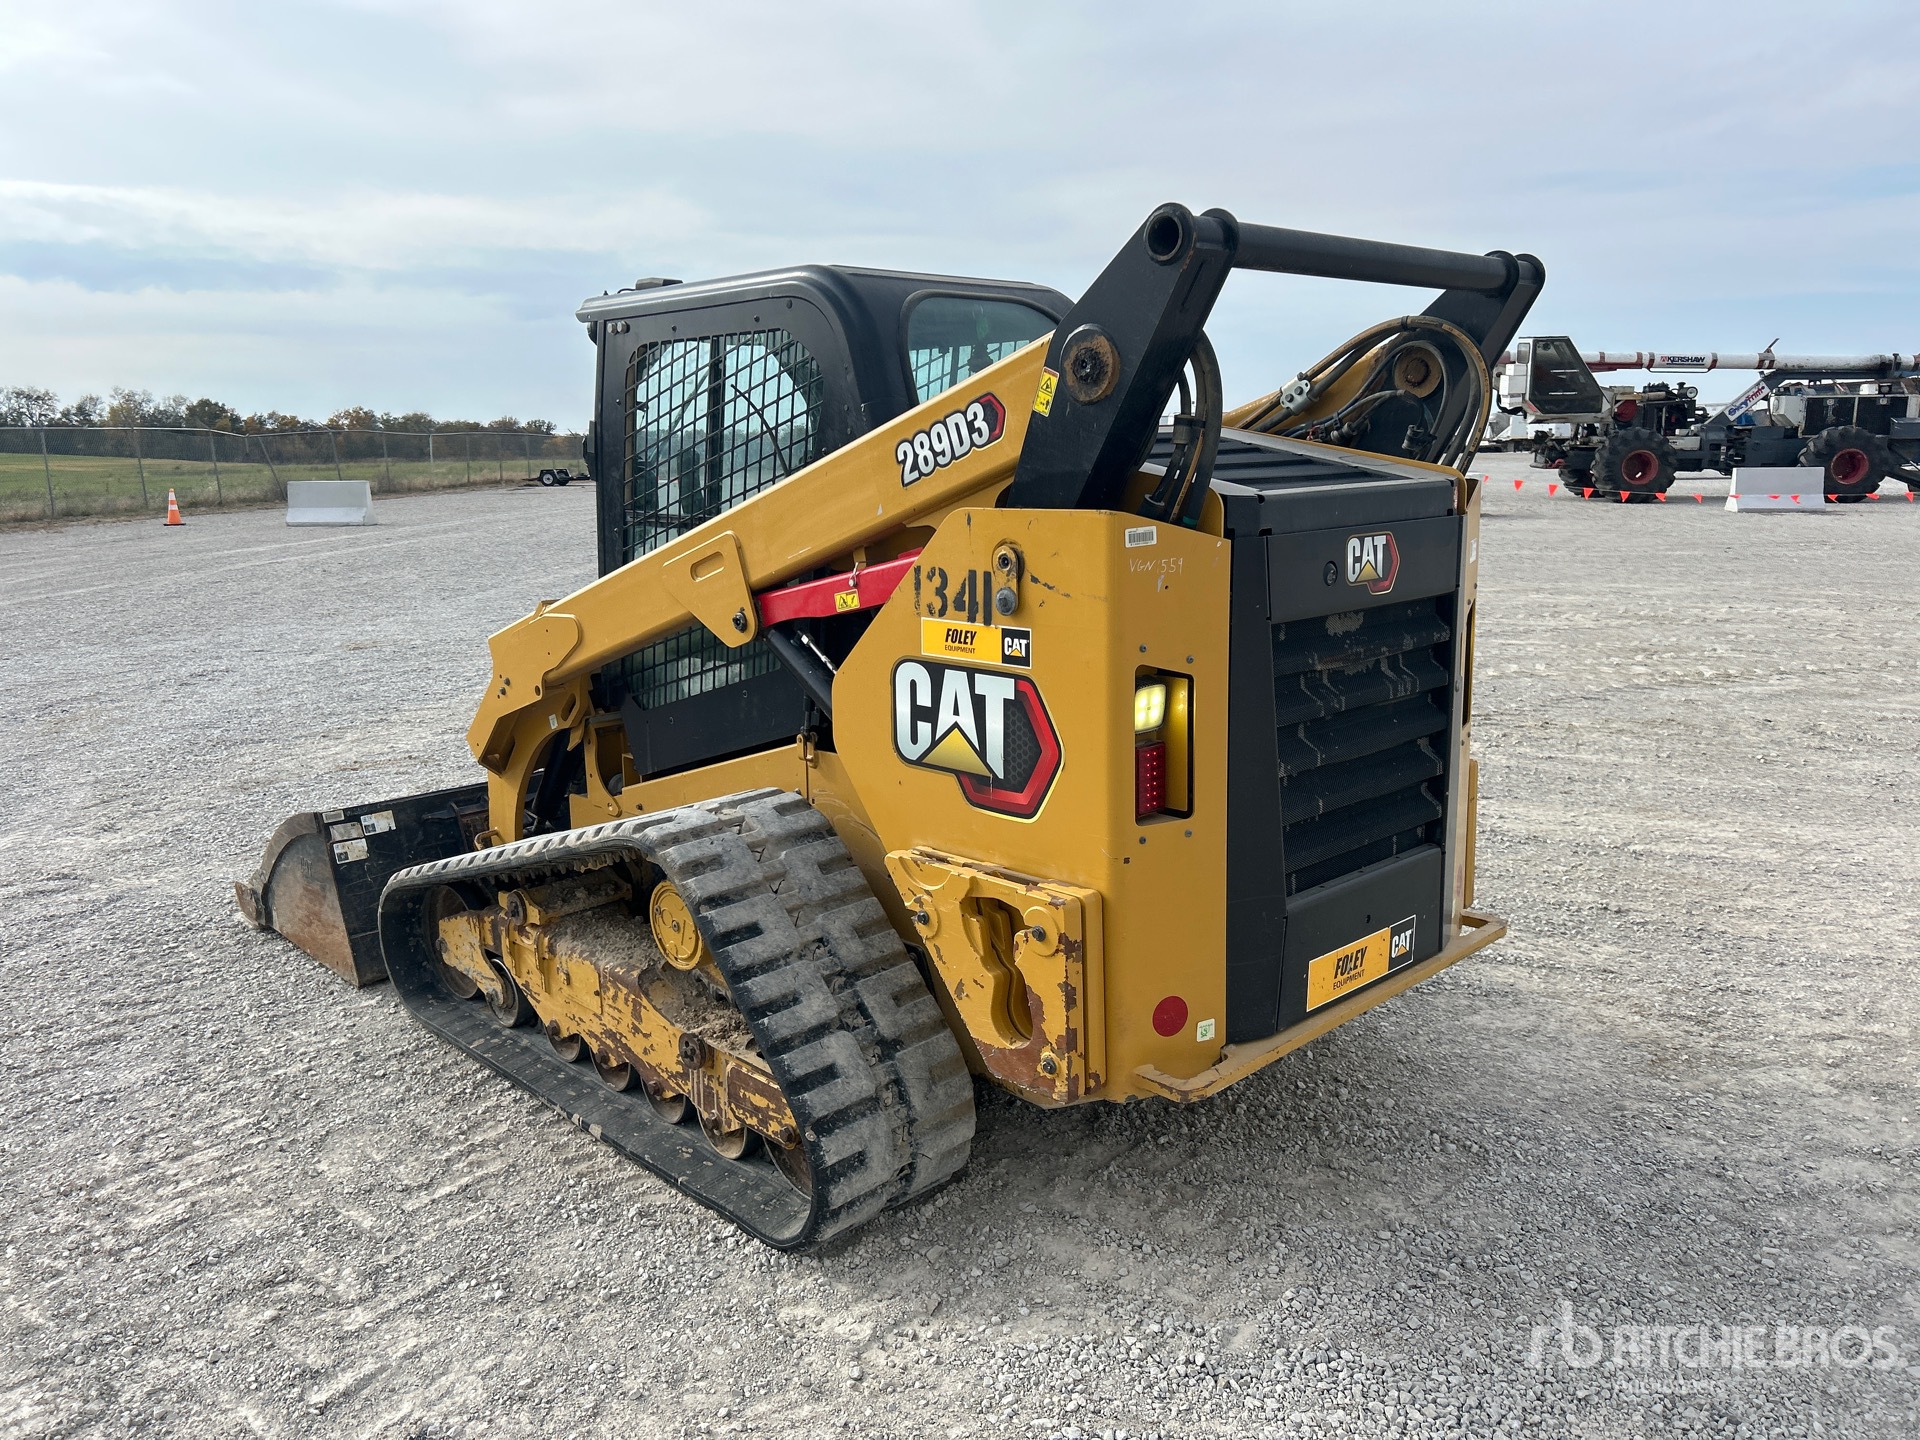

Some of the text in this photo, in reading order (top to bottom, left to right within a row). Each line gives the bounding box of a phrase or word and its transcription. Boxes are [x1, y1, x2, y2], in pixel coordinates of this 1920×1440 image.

[1667, 355, 1706, 363] KERSHAW
[896, 401, 990, 484] 289D3
[1129, 557, 1157, 573] VGN
[1347, 534, 1387, 583] CAT
[914, 565, 992, 626] 1341
[944, 627, 1028, 657] FOLEY CAT
[944, 644, 976, 654] EQUIPMENT
[895, 661, 1015, 779] CAT
[1334, 928, 1413, 980] FOLEY CAT
[1333, 969, 1366, 990] EQUIPMENT
